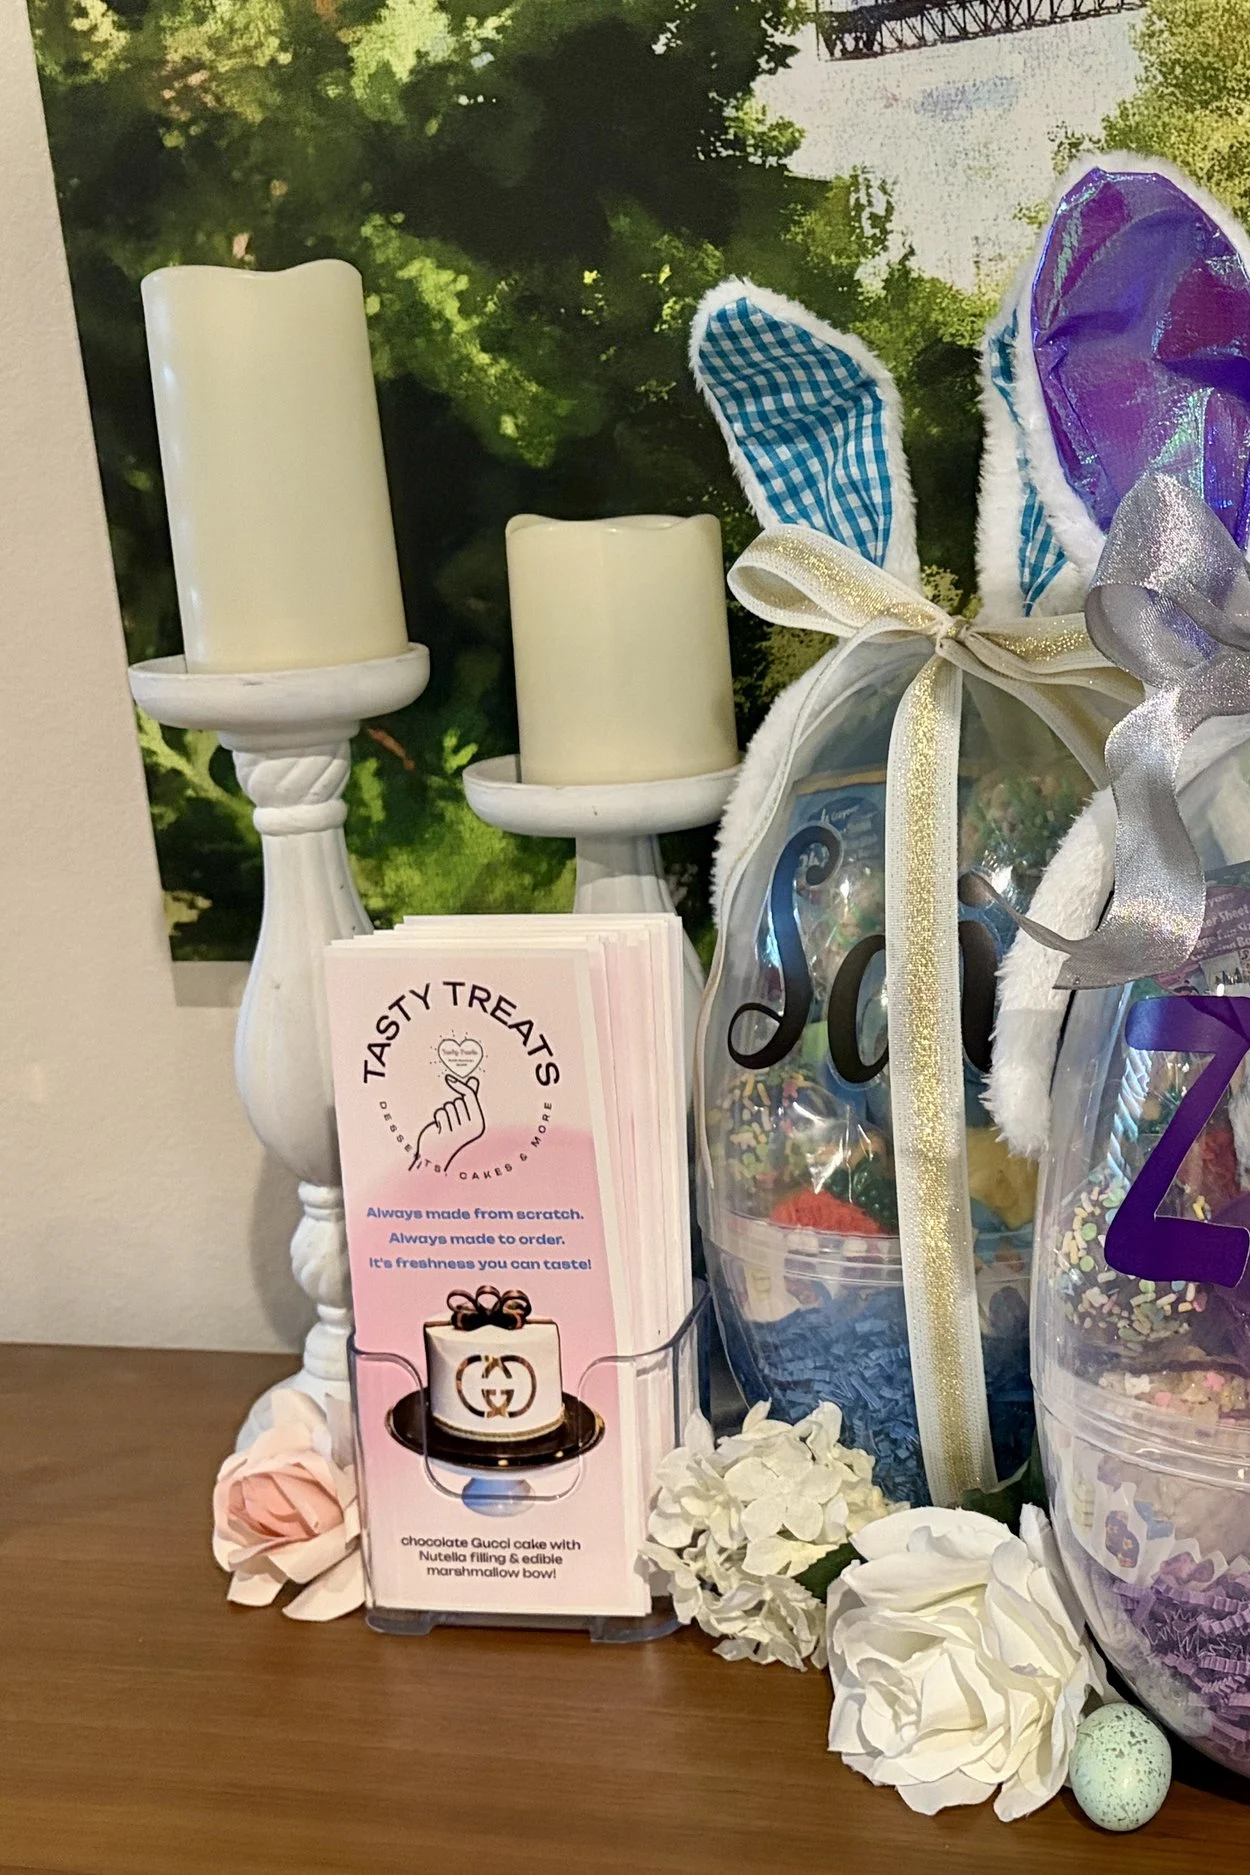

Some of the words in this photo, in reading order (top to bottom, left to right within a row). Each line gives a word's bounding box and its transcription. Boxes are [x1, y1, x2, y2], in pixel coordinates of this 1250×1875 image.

[363, 982, 431, 1084] TASTY
[442, 980, 561, 1087] TREATS
[459, 1163, 513, 1181] CAKES
[530, 1102, 553, 1148] MORE
[366, 1207, 423, 1221] Always
[425, 1208, 471, 1220] made
[474, 1208, 514, 1220] from
[516, 1208, 585, 1221] scratch.
[389, 1232, 448, 1247] Always
[450, 1233, 496, 1245] made
[498, 1233, 517, 1245] to
[518, 1233, 566, 1245] order.
[369, 1257, 393, 1269] It's
[395, 1257, 476, 1270] freshness
[478, 1260, 508, 1271] you
[510, 1260, 541, 1270] can
[543, 1258, 592, 1270] taste!
[400, 1535, 469, 1549] chocolate
[471, 1536, 511, 1550] Gucci
[513, 1537, 547, 1550] cake
[549, 1538, 582, 1551] with
[418, 1550, 468, 1563] Nutella
[470, 1551, 507, 1566] filling
[509, 1553, 520, 1565] &
[521, 1553, 563, 1565] edible
[426, 1565, 520, 1579] marshmallow
[522, 1567, 557, 1579] bow!
